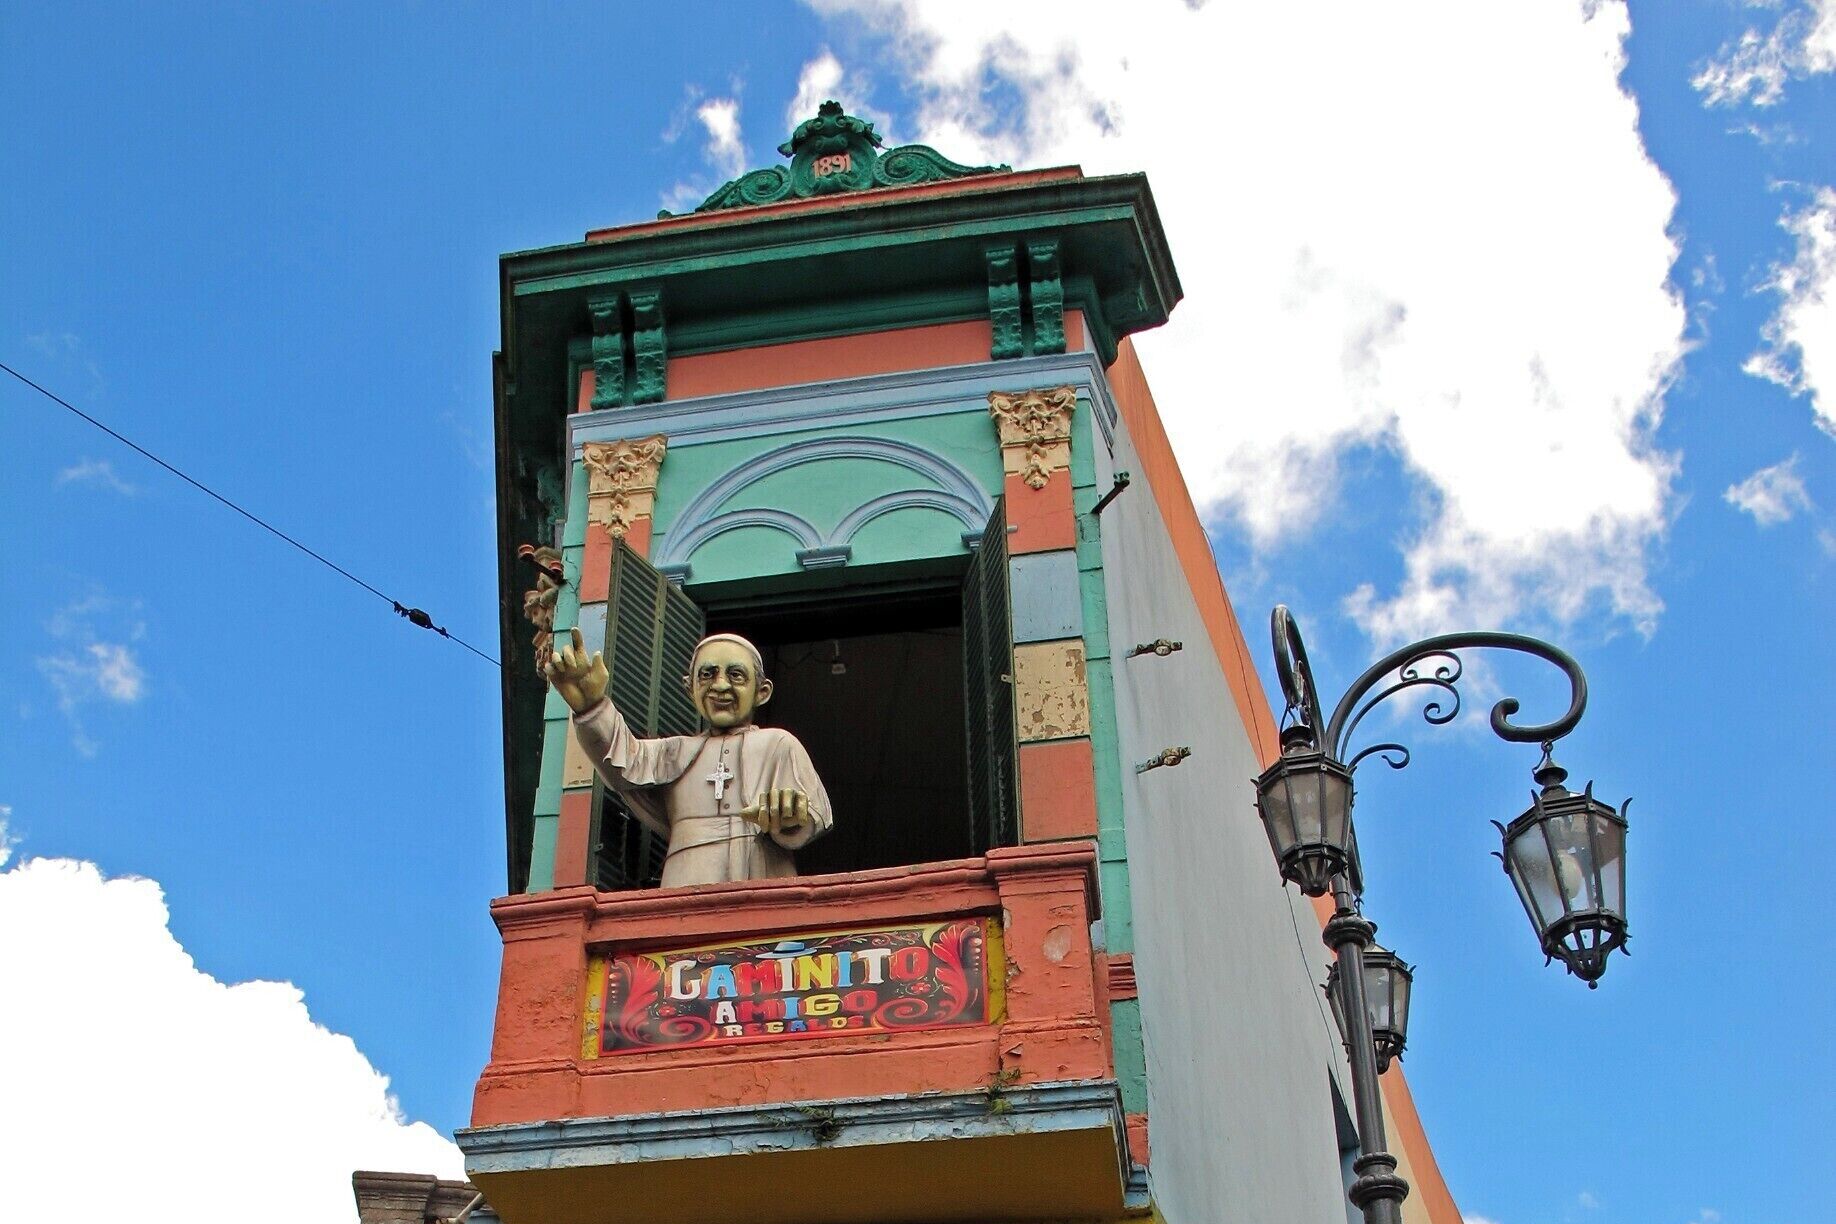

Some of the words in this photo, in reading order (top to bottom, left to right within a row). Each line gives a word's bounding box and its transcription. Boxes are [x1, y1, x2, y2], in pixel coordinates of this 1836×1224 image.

[812, 154, 851, 178] 1891
[667, 947, 929, 1000] CAMINITO
[713, 990, 878, 1024] AMIGO
